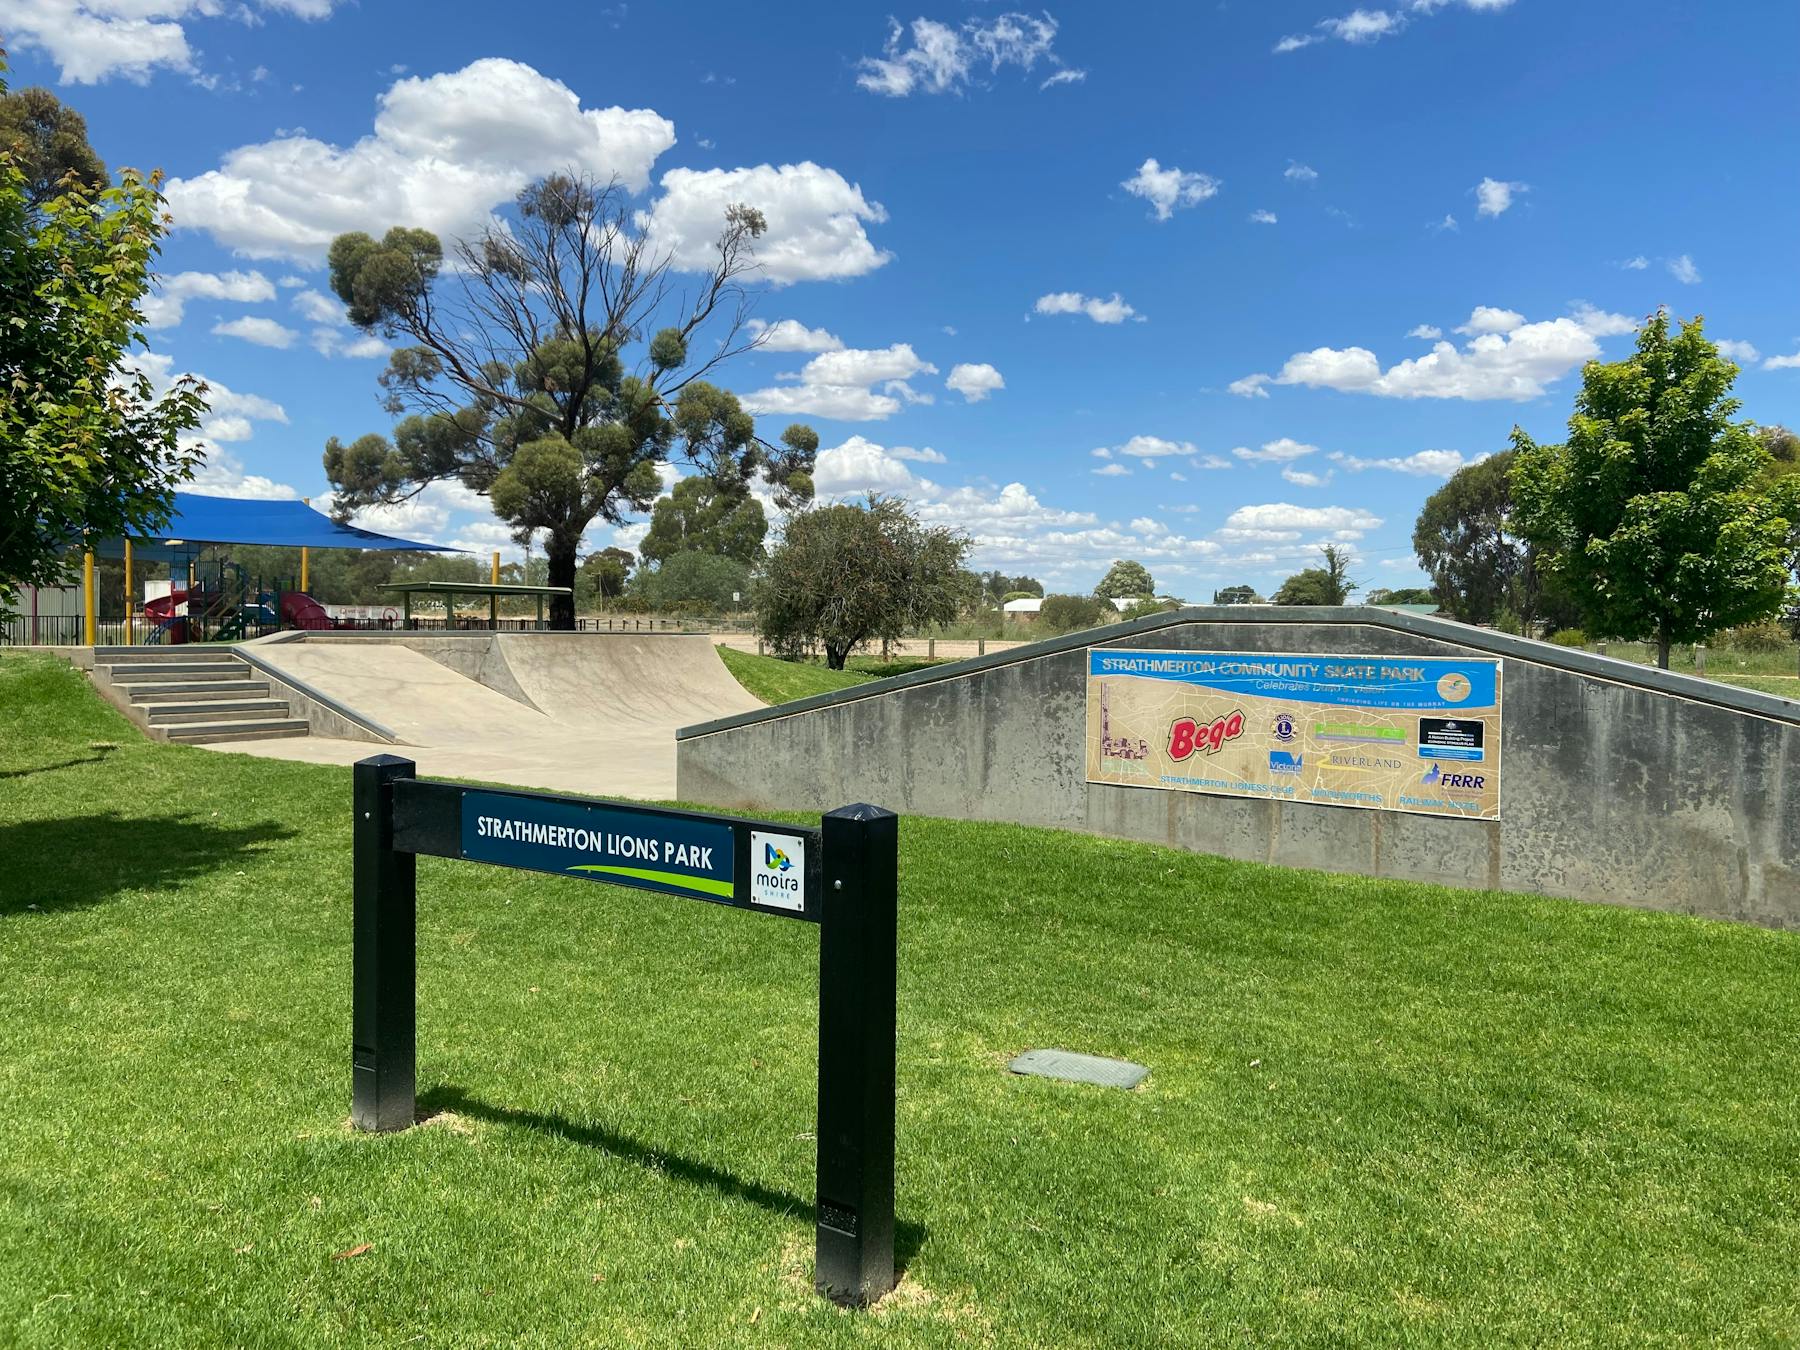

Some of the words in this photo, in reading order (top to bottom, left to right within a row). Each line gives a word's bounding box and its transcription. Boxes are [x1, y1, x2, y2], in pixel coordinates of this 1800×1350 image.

[1102, 658, 1216, 675] STRATHMERTON
[1219, 661, 1319, 677] COMMUNITY
[1323, 664, 1376, 680] SKATE
[1380, 666, 1426, 682] PARK
[1168, 713, 1243, 760] Bega
[1270, 761, 1302, 772] Victoria
[1332, 755, 1402, 769] RIVERLAND
[1160, 776, 1228, 789] STRATHMERTON
[1230, 782, 1268, 792] LIONESS
[1270, 785, 1295, 795] CLUB
[1441, 773, 1485, 789] FRRR
[477, 815, 602, 853] STRATHMERTON
[607, 833, 659, 862] LIONS
[664, 841, 714, 871] PARK
[756, 873, 799, 892] moira
[764, 889, 791, 900] SHIRE
